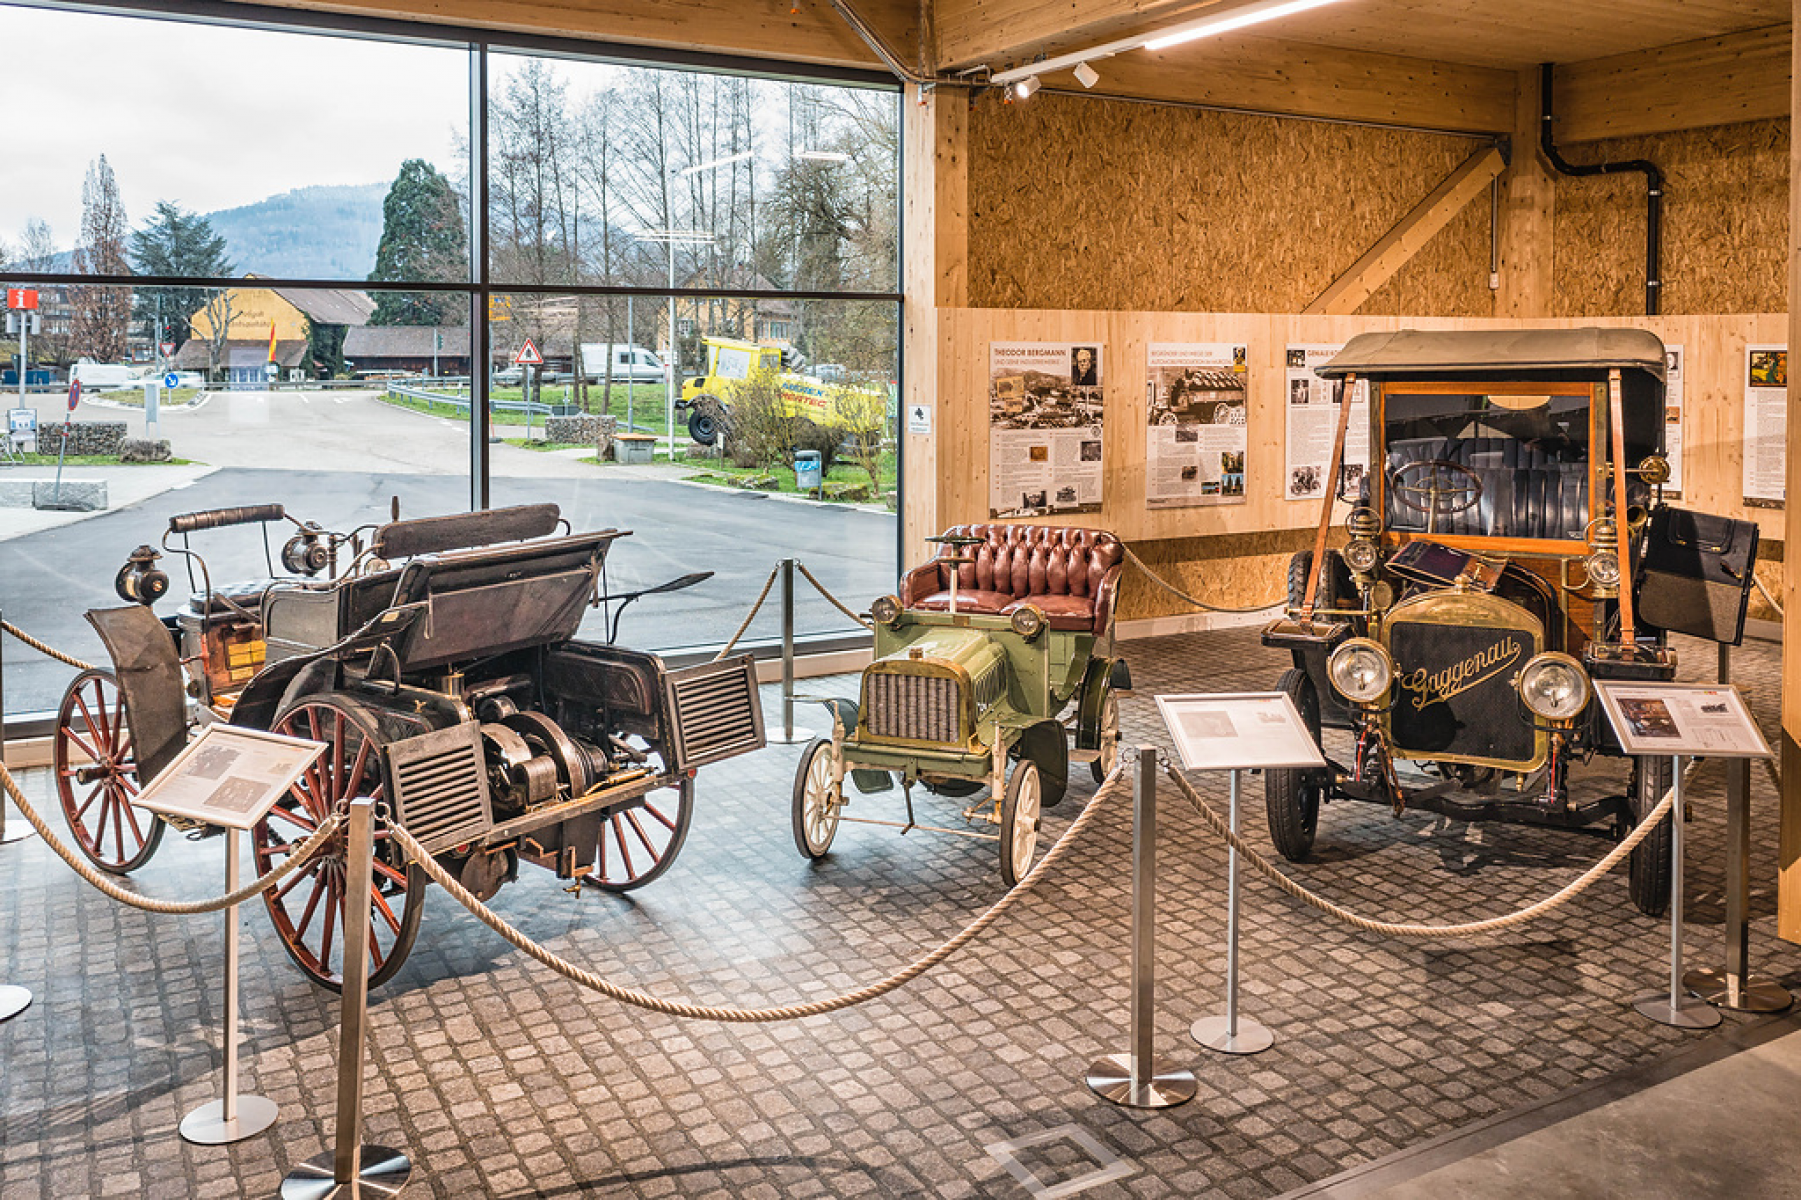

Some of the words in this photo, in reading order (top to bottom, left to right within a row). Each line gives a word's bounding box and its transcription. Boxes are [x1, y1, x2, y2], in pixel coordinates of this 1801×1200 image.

[994, 348, 1026, 357] THEODOR
[1027, 349, 1066, 357] BERGMANN
[1401, 636, 1521, 711] Gaggenau
